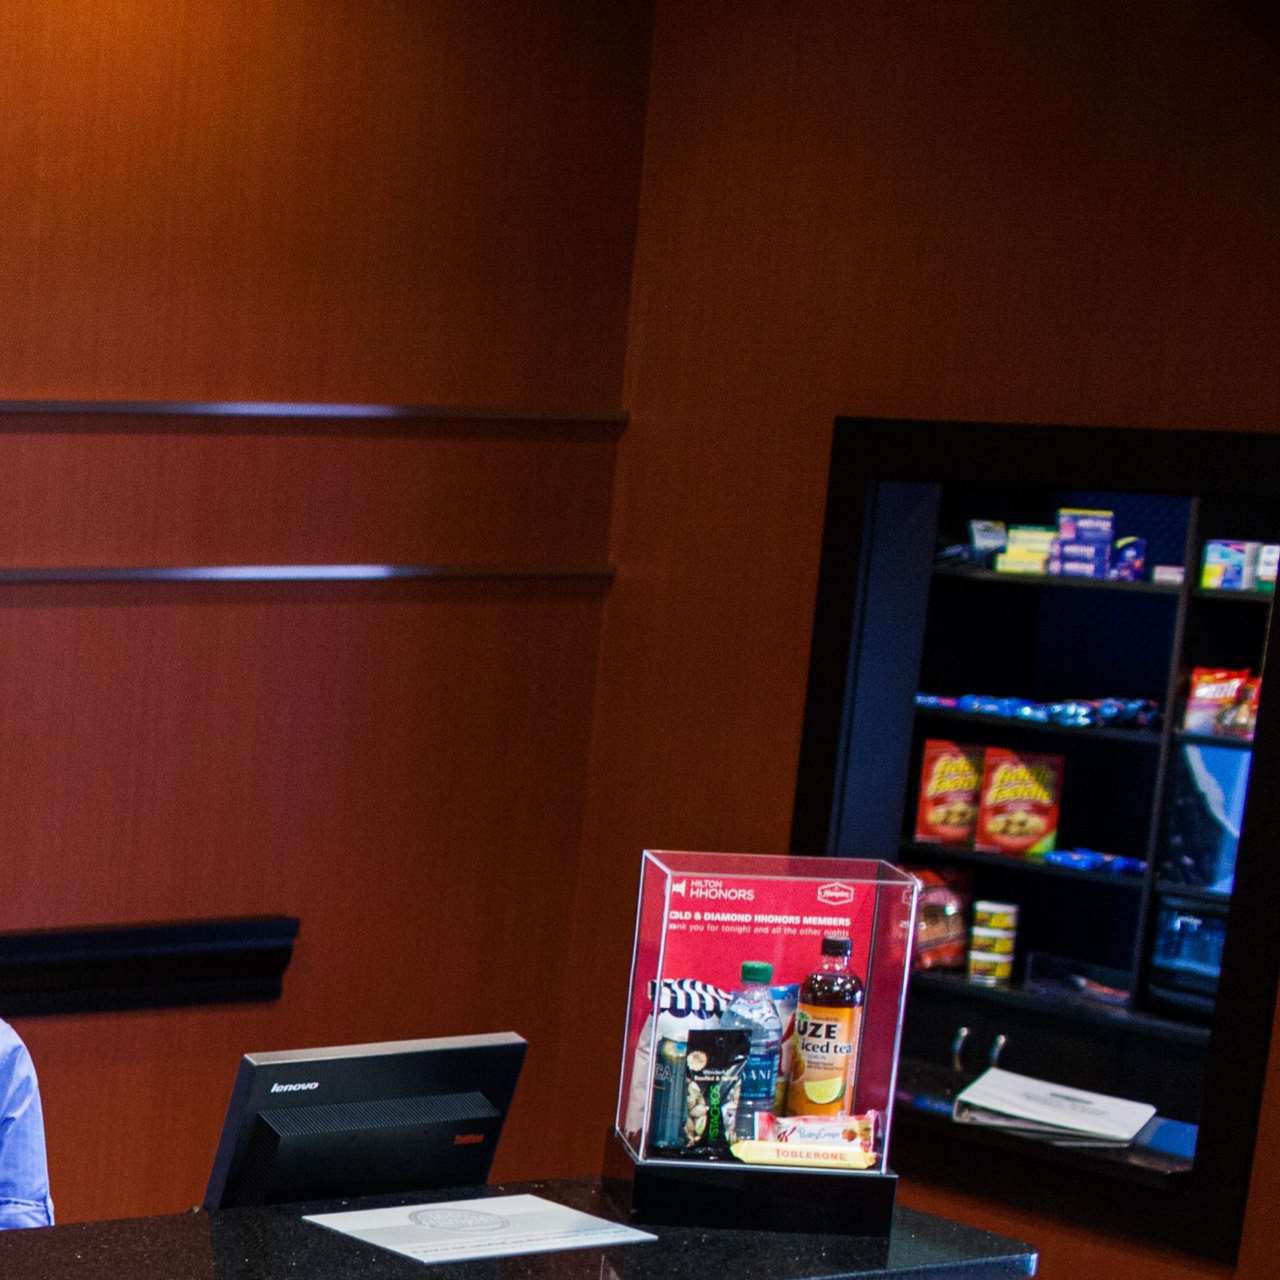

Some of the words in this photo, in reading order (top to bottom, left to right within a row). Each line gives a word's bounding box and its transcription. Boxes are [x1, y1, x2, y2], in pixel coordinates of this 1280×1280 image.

[691, 880, 722, 888] HILTON
[690, 888, 755, 901] HHONORS
[704, 912, 752, 923] DIAMOND
[802, 916, 851, 927] MEMBERS
[721, 925, 752, 935] tonight
[797, 1020, 838, 1040] UZE
[801, 1040, 831, 1054] iced
[270, 1081, 320, 1093] lenovo
[775, 1148, 847, 1161] TOBLERONE
